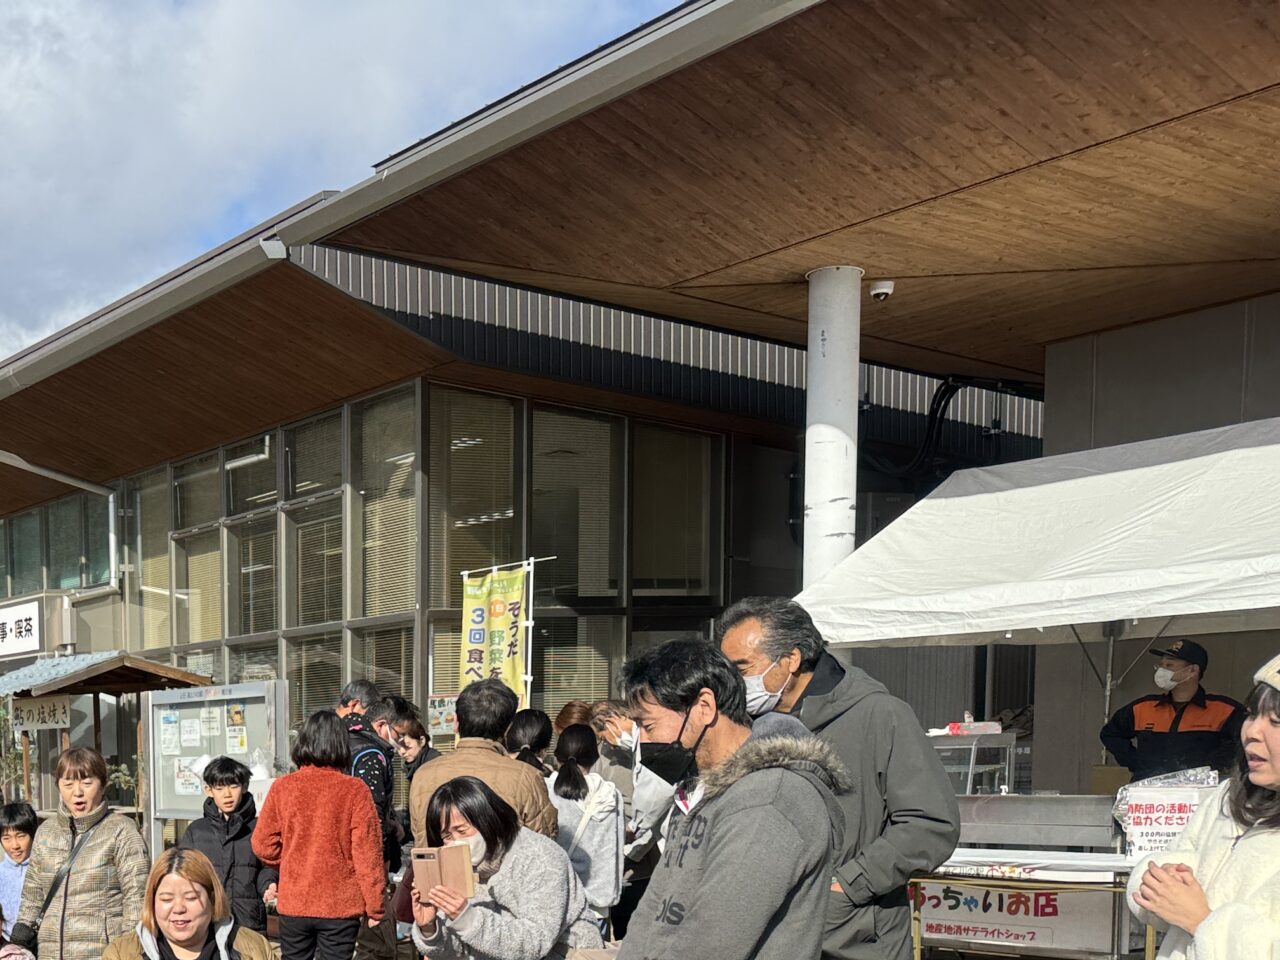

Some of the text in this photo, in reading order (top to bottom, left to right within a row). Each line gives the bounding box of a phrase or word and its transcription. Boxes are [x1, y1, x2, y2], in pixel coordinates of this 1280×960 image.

[465, 607, 486, 684] 3回食べ
[488, 629, 506, 680] 野菜を
[506, 601, 521, 658] そうだ
[14, 702, 68, 727] 鮎の塩焼き
[925, 923, 1036, 941] 地産地消サテライトショップ
